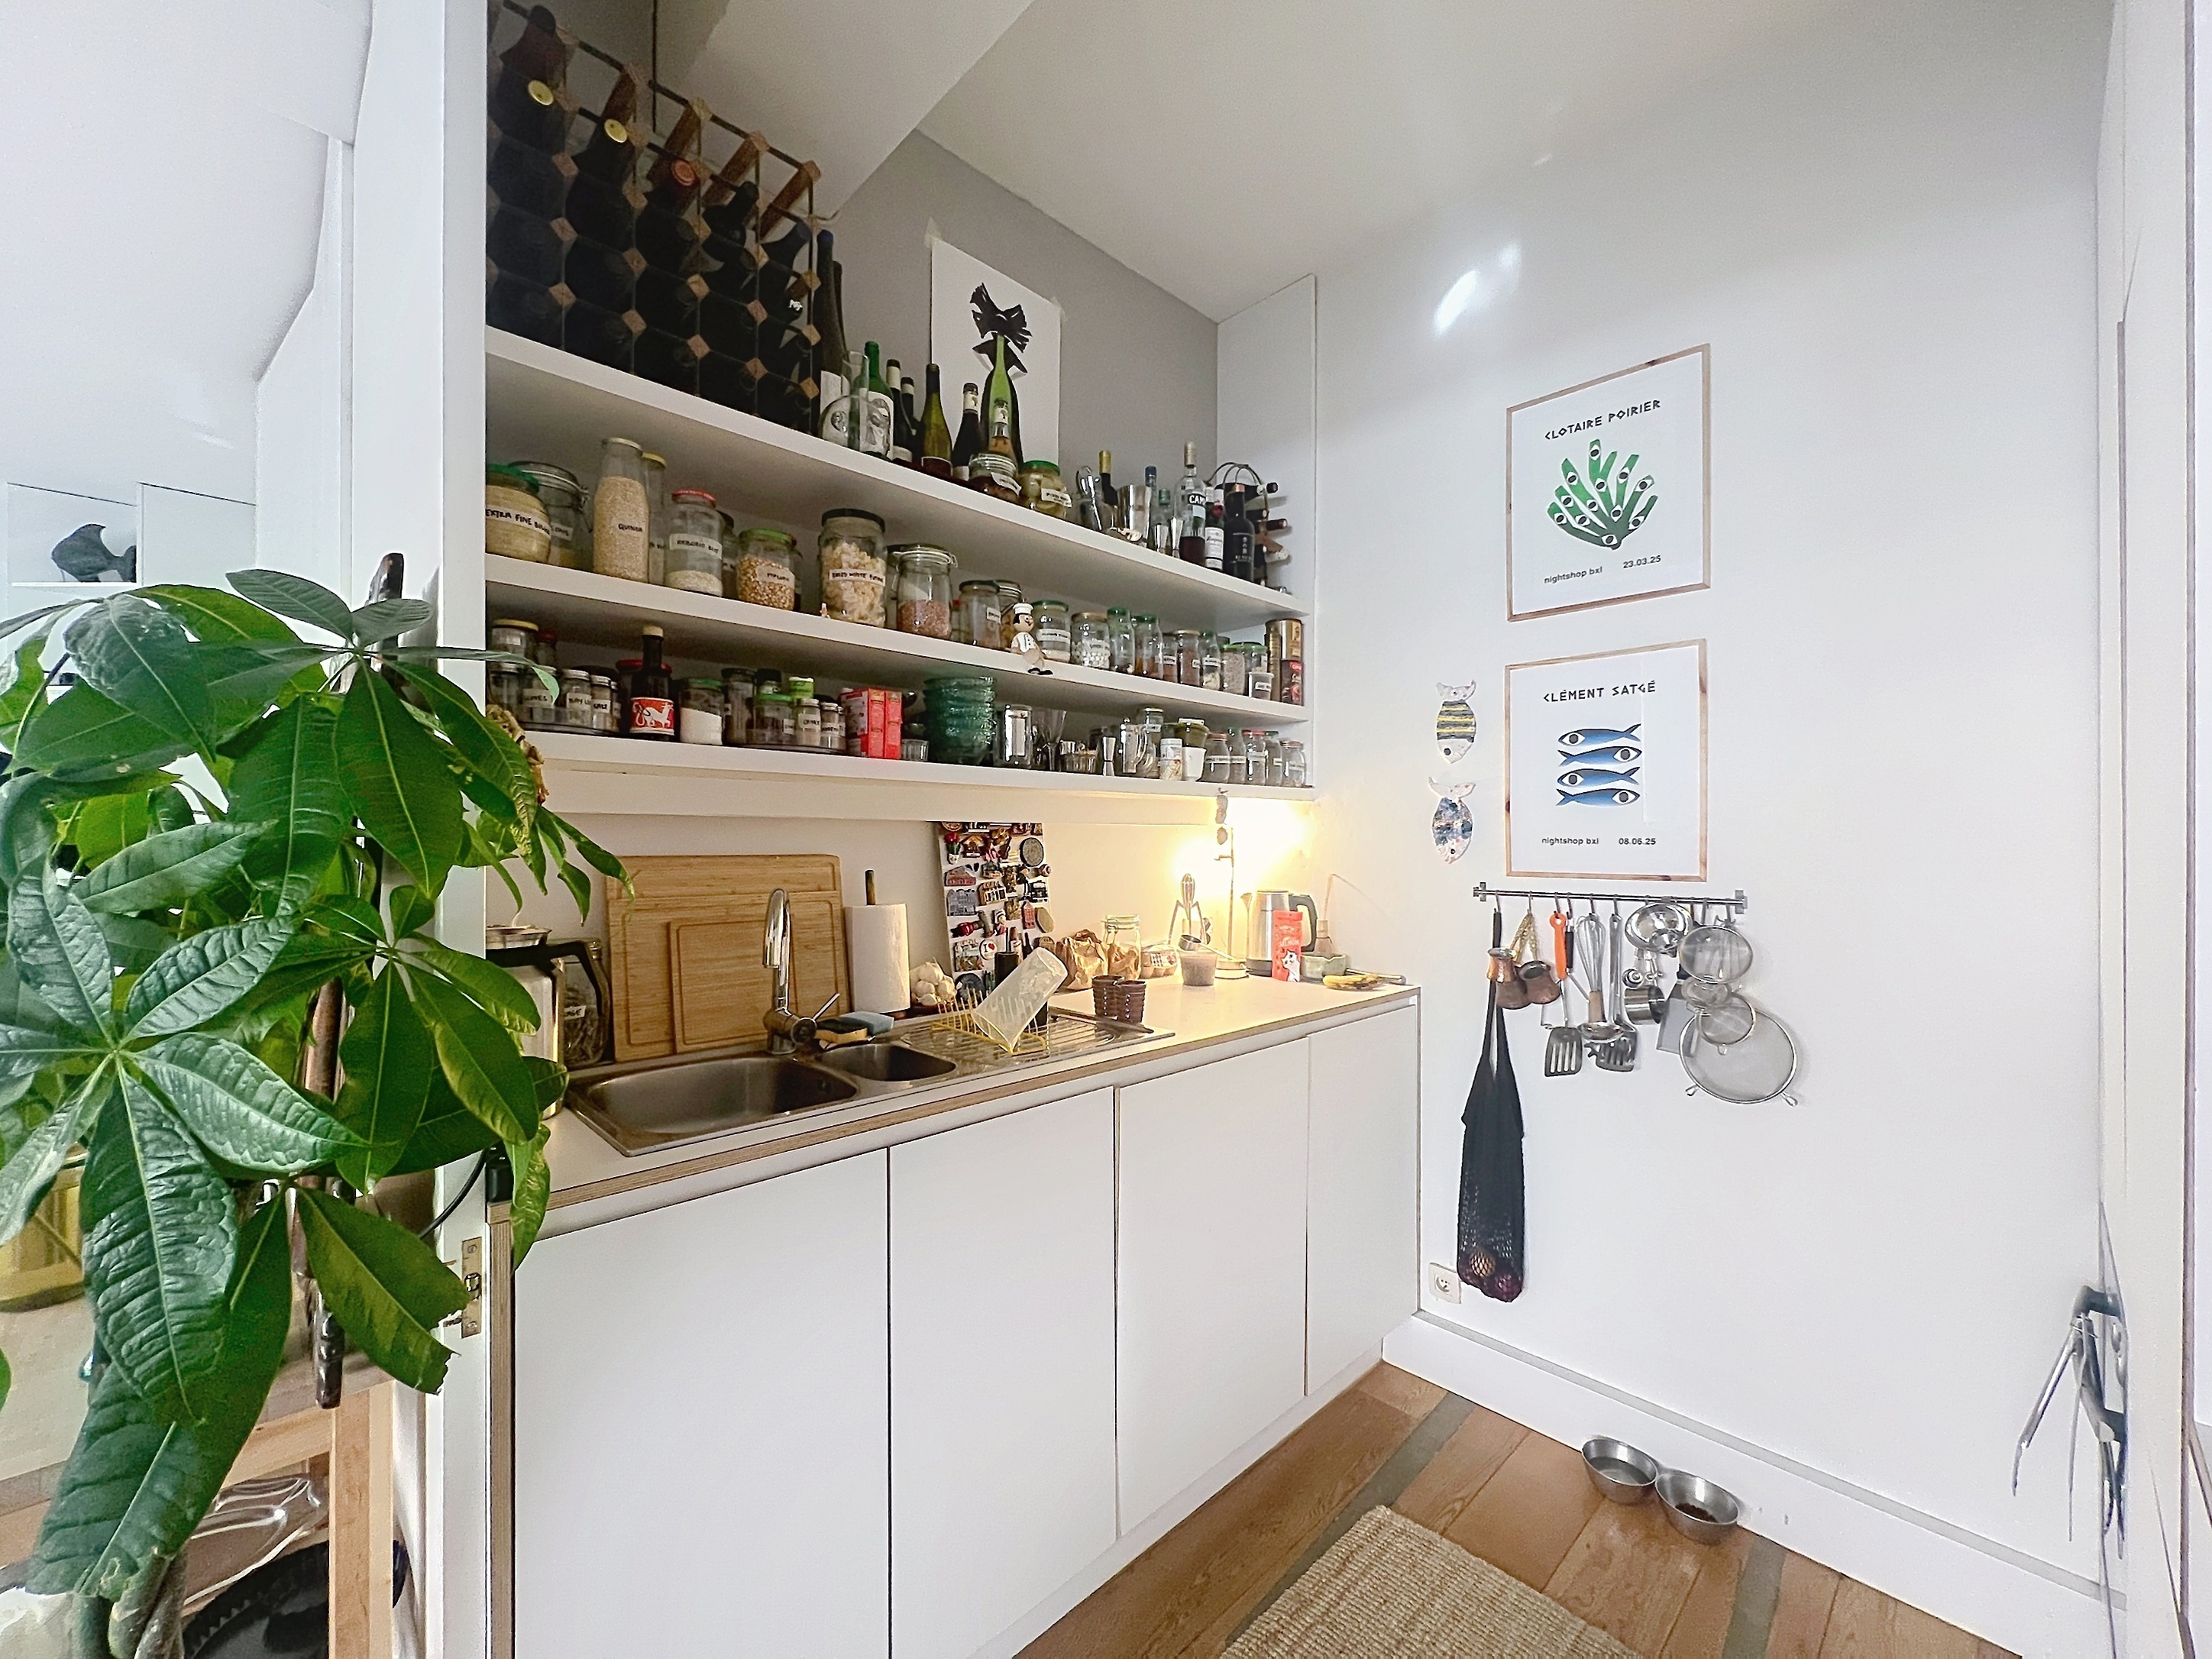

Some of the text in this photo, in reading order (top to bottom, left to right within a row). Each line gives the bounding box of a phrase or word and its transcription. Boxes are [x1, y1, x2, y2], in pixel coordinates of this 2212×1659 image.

[1544, 399, 1661, 440] CLOTAIRE POIRIER
[485, 509, 512, 518] EXTRA
[515, 514, 532, 526] FINE
[1623, 555, 1661, 568] 23.03.25
[1544, 566, 1602, 584] nightshop bxl
[1543, 680, 1656, 702] CLÉMENT SATGÉ
[1541, 836, 1583, 846] nightshop
